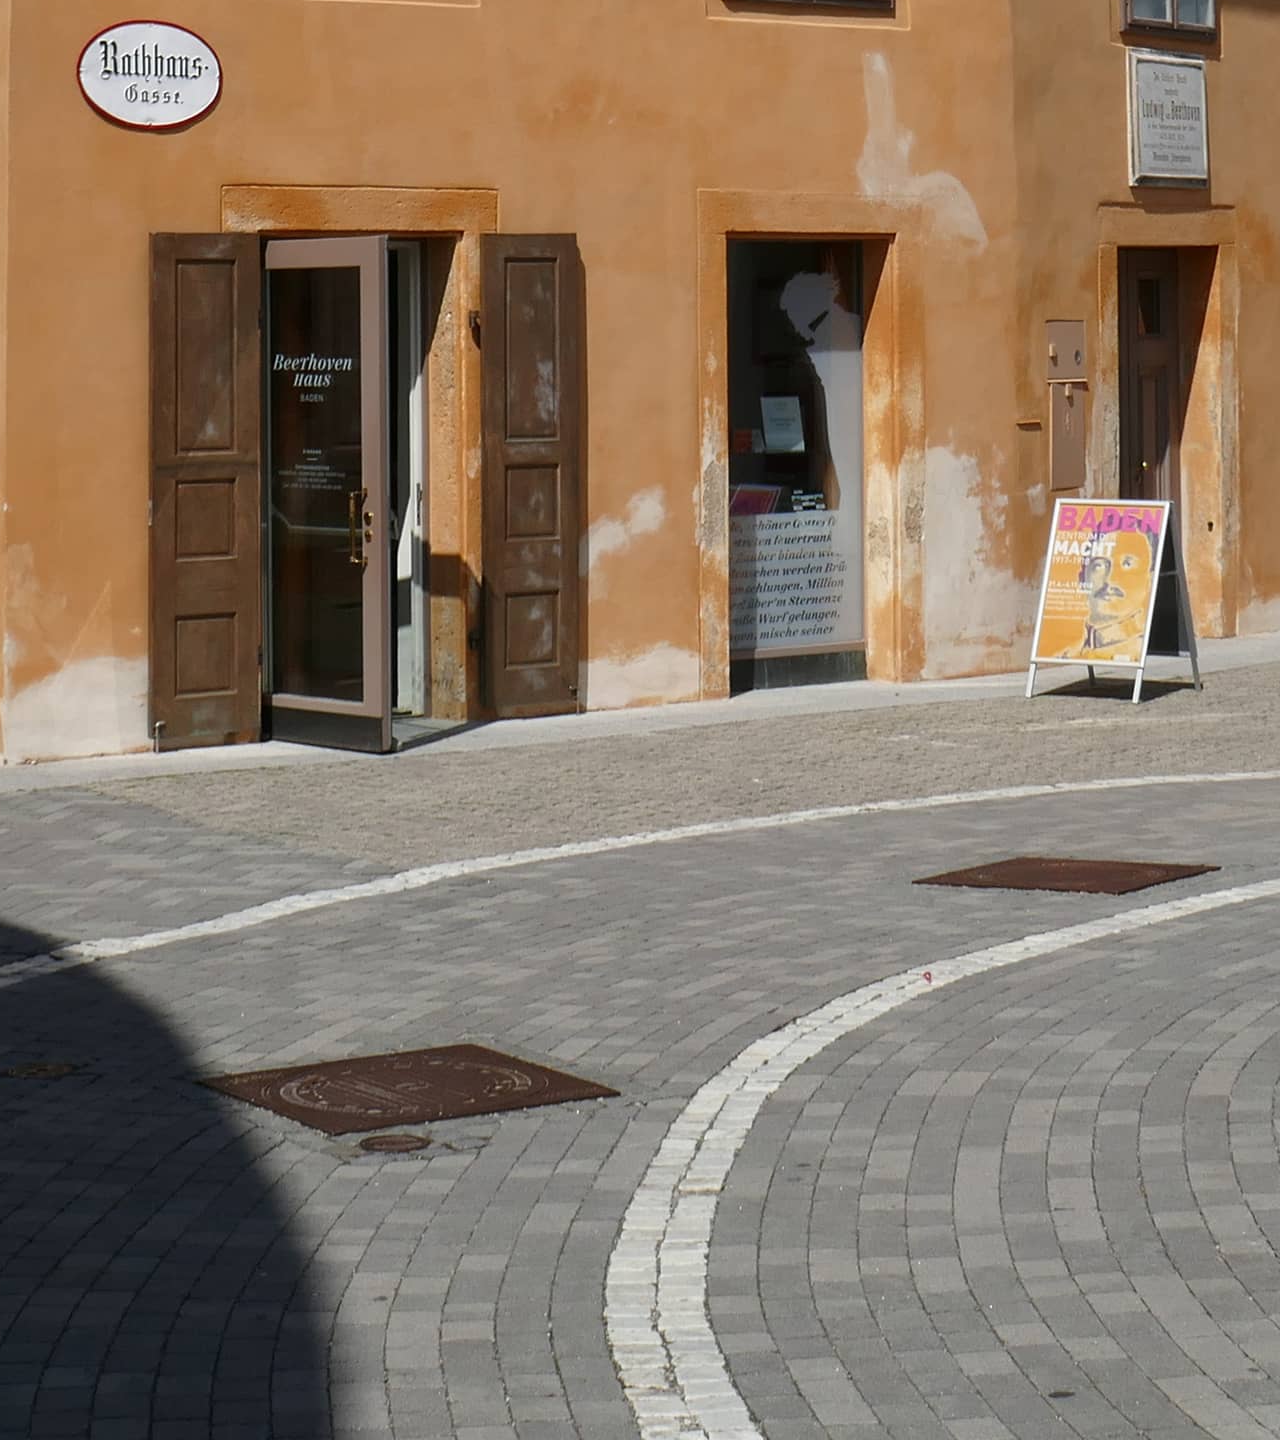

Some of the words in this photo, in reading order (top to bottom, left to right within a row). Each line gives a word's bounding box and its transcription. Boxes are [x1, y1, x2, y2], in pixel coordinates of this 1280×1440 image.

[300, 393, 324, 402] BADEN
[1058, 506, 1162, 534] BADEN
[1054, 541, 1116, 556] MACHT
[778, 550, 815, 561] binden
[782, 565, 822, 576] werden
[759, 612, 788, 624] Wurf
[760, 628, 799, 640] mische
[801, 625, 835, 636] seiner
